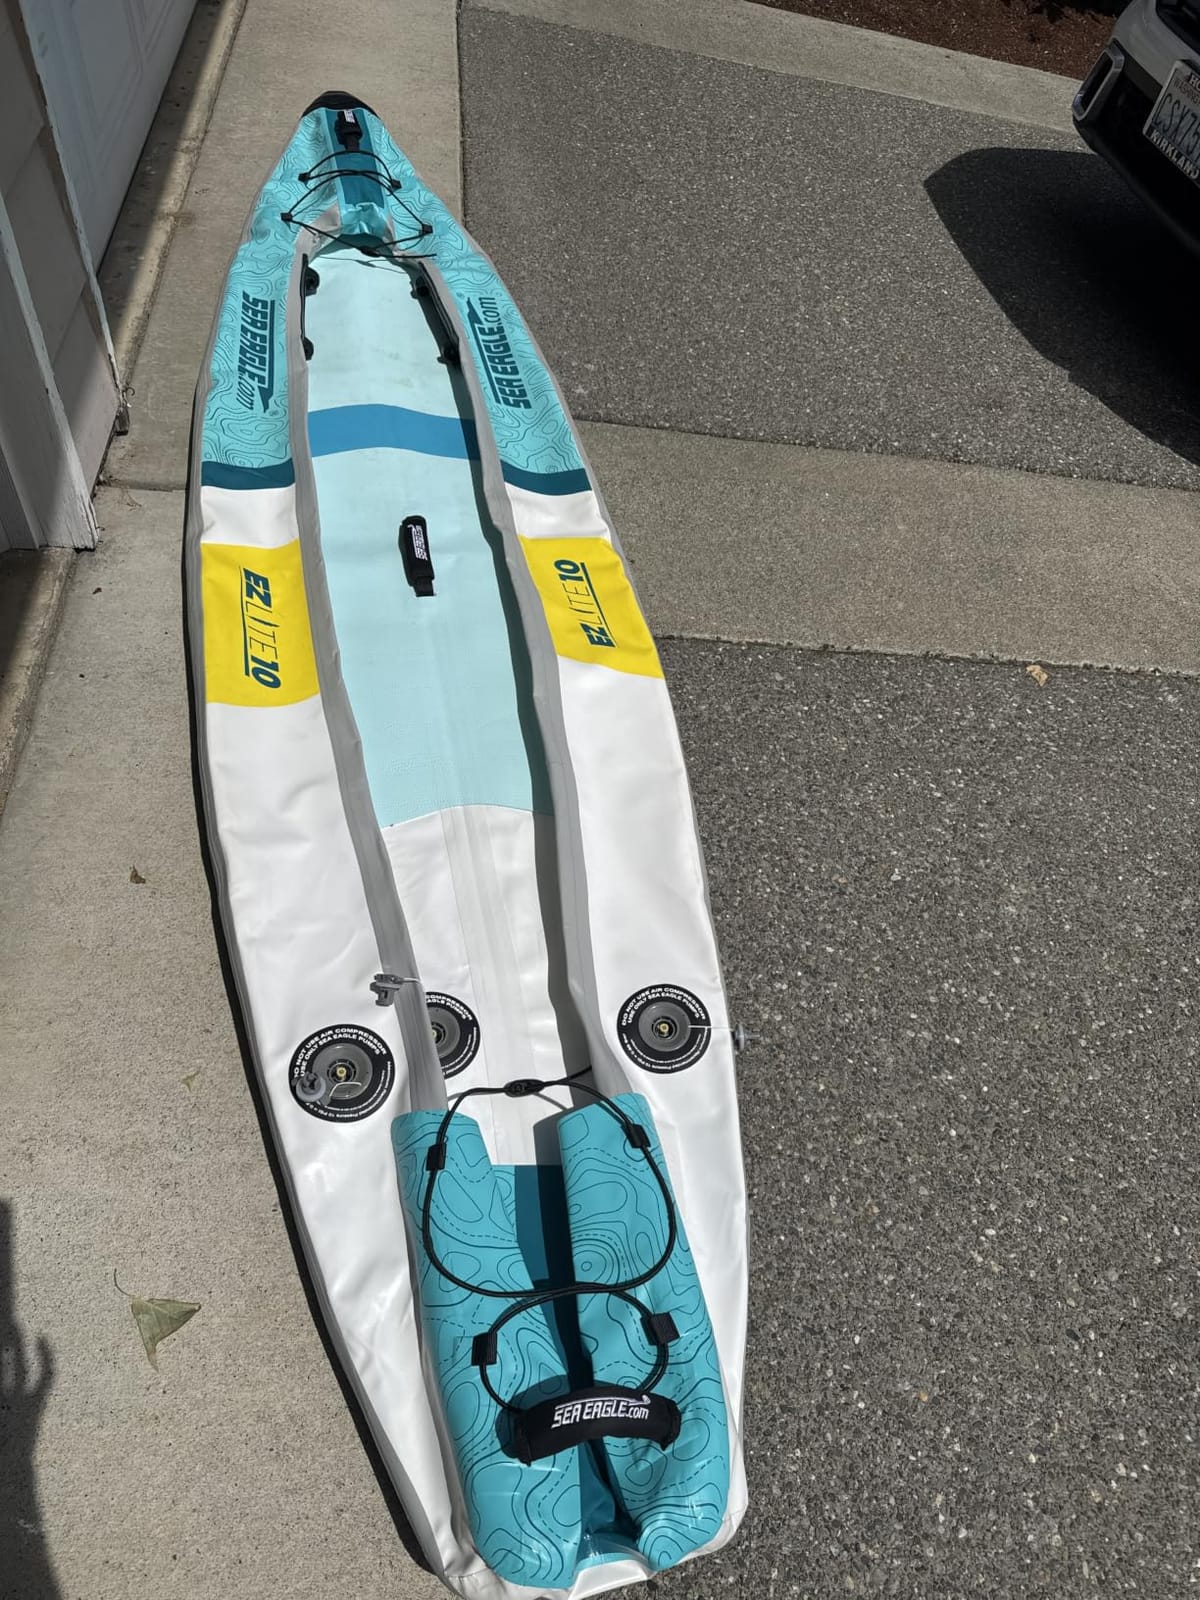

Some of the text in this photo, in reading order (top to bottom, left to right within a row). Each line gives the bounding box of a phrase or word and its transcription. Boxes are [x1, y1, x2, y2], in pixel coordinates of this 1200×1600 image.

[1152, 92, 1200, 165] CSX75
[1150, 129, 1199, 180] KIRKLAND
[236, 290, 269, 411] SEA EAGLE.com
[479, 297, 533, 410] SEA EAGLE.com
[621, 1013, 628, 1026] DO
[626, 998, 636, 1013] NOT
[636, 990, 650, 1000] USE
[664, 987, 706, 1020] COMPRESSOR
[627, 1010, 636, 1024] USE
[633, 998, 647, 1010] ONLY
[661, 992, 682, 1001] EAGLE
[682, 998, 700, 1018] PUMPS
[295, 1048, 306, 1066] NOT
[305, 1036, 320, 1049] USE
[320, 1030, 334, 1038] AIR
[335, 1027, 387, 1055] COMPRESSOR
[300, 1060, 308, 1077] USE
[304, 1044, 319, 1060] ONLY
[318, 1037, 333, 1046] SEA
[358, 1036, 381, 1055] PUMPS
[551, 1400, 650, 1429] SEA EAGLE.com
